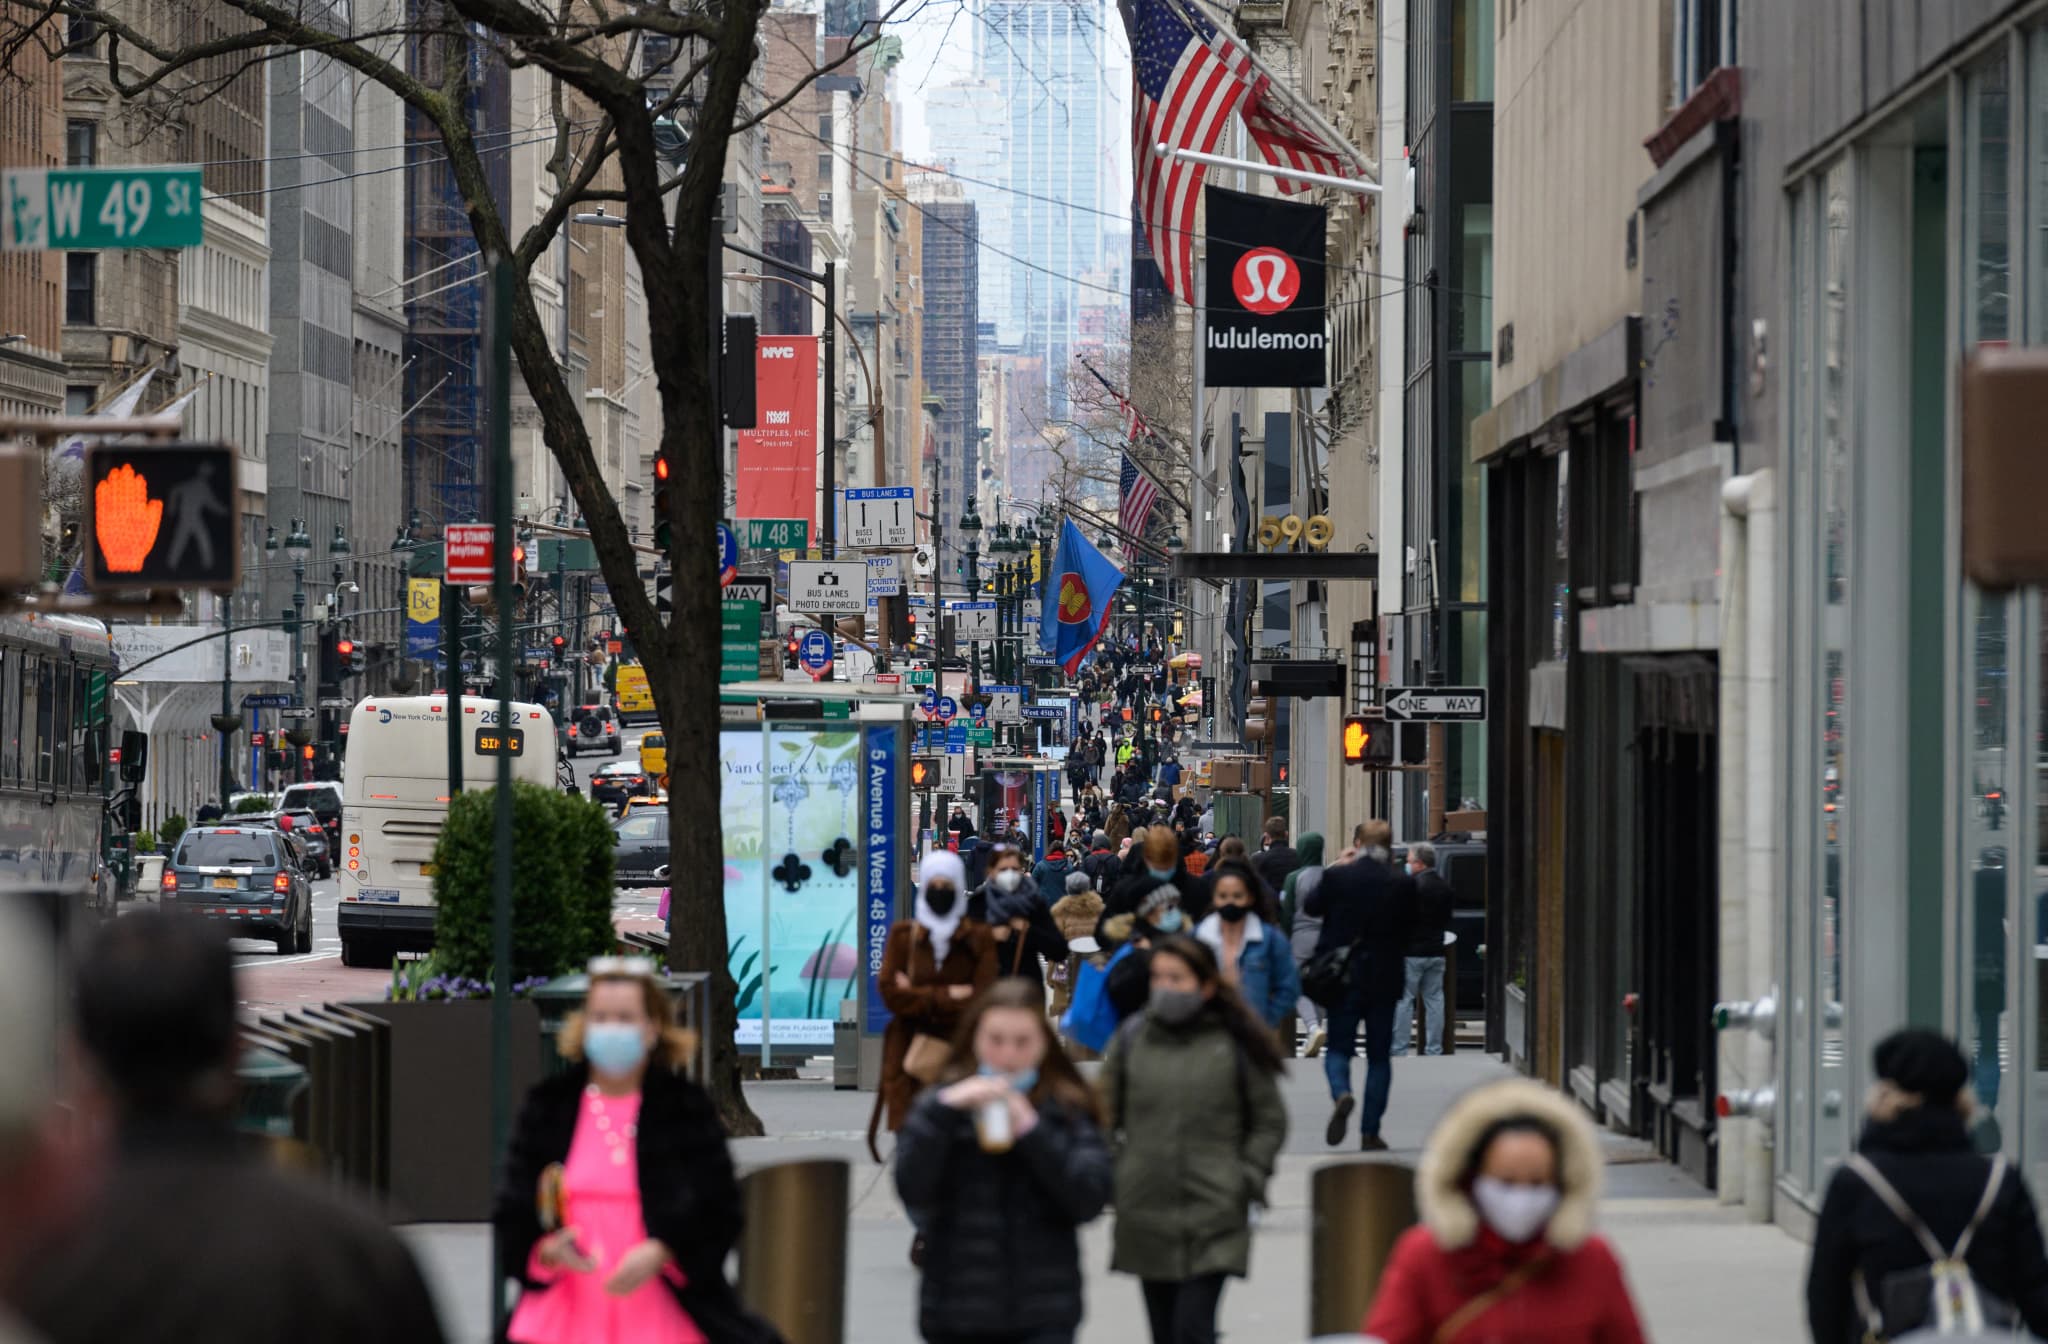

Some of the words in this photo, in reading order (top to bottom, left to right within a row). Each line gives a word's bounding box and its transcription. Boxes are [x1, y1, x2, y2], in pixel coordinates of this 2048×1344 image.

[51, 181, 84, 238] W
[98, 179, 150, 238] 49
[165, 178, 192, 216] St
[1207, 326, 1323, 349] lululemon
[762, 346, 794, 359] NYC
[743, 430, 792, 438] MULTIPLES,
[876, 489, 898, 497] LANES
[449, 531, 461, 543] NO
[750, 523, 763, 544] W
[769, 523, 788, 545] 48
[794, 524, 804, 537] St
[856, 537, 871, 545] ONLY
[450, 545, 485, 559] Anytime
[867, 558, 893, 567] NYPD
[868, 577, 898, 585] ECURITY
[726, 586, 761, 600] WAY
[795, 601, 820, 609] PHOTO
[822, 601, 860, 609] ENFORCED
[1029, 657, 1043, 665] West
[914, 672, 923, 682] 47
[1398, 698, 1428, 710] ONE
[1445, 698, 1477, 710] WAY
[421, 714, 435, 722] City
[481, 710, 520, 724] 262
[1040, 709, 1055, 717] 45th
[870, 749, 887, 761] 5
[725, 761, 752, 774] Van
[756, 761, 793, 774] Ceef
[799, 763, 809, 774] &
[870, 764, 887, 829] Avenue
[870, 833, 887, 846] &
[870, 850, 886, 895] West
[870, 898, 886, 920] 48
